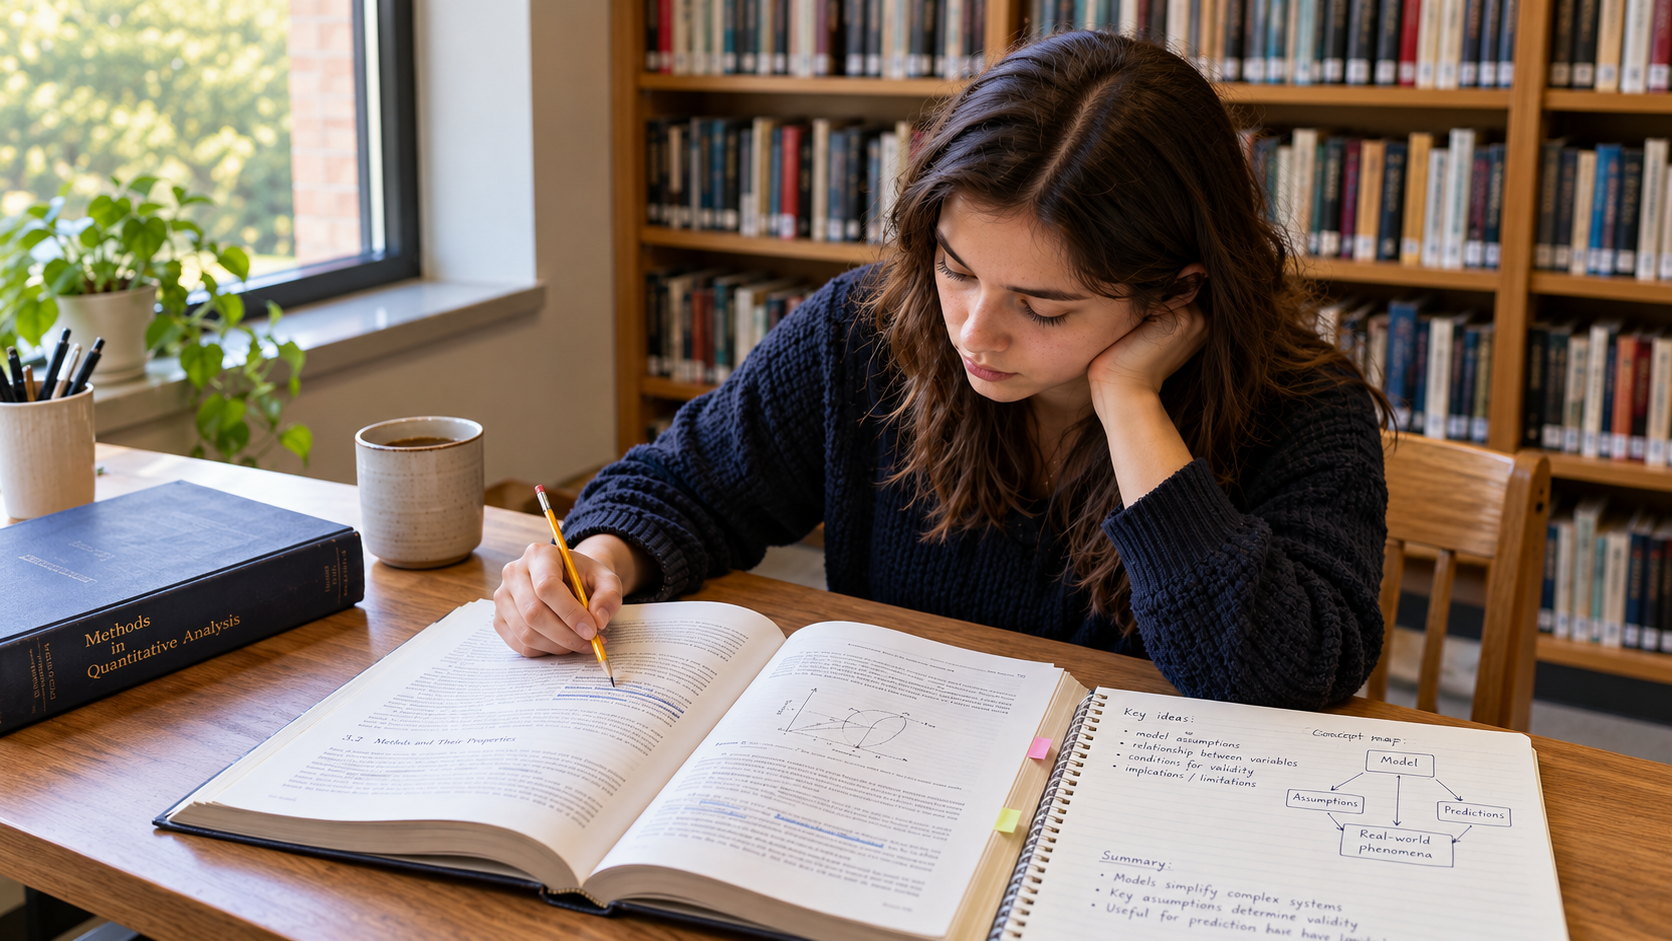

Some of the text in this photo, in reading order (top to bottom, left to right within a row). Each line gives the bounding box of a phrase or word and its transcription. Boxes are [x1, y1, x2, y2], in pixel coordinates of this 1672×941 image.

[84, 615, 151, 647] Methods
[87, 639, 178, 679] Quantitative
[182, 614, 241, 644] Analysis
[110, 641, 126, 655] in
[1124, 708, 1194, 723] Key ideas:
[467, 735, 516, 746] Properties
[1136, 730, 1169, 740] model
[1128, 753, 1180, 767] conditions
[1186, 760, 1203, 771] for
[1132, 742, 1298, 768] relationship between variables
[1380, 756, 1418, 767] Model
[1200, 774, 1257, 788] limitations
[1292, 792, 1358, 808] Assumptions
[1444, 806, 1505, 820] Predictions
[1360, 829, 1431, 845] Real-world
[1358, 844, 1433, 859] phenomena
[1101, 850, 1172, 871] Summary:
[1114, 872, 1342, 912] Models simplify complex systems
[1106, 903, 1149, 920] Useful
[1160, 910, 1180, 922] for
[1188, 915, 1257, 932] prediction
[1110, 888, 1133, 903] Key
[1232, 904, 1297, 922] determine
[1307, 915, 1358, 932] validity
